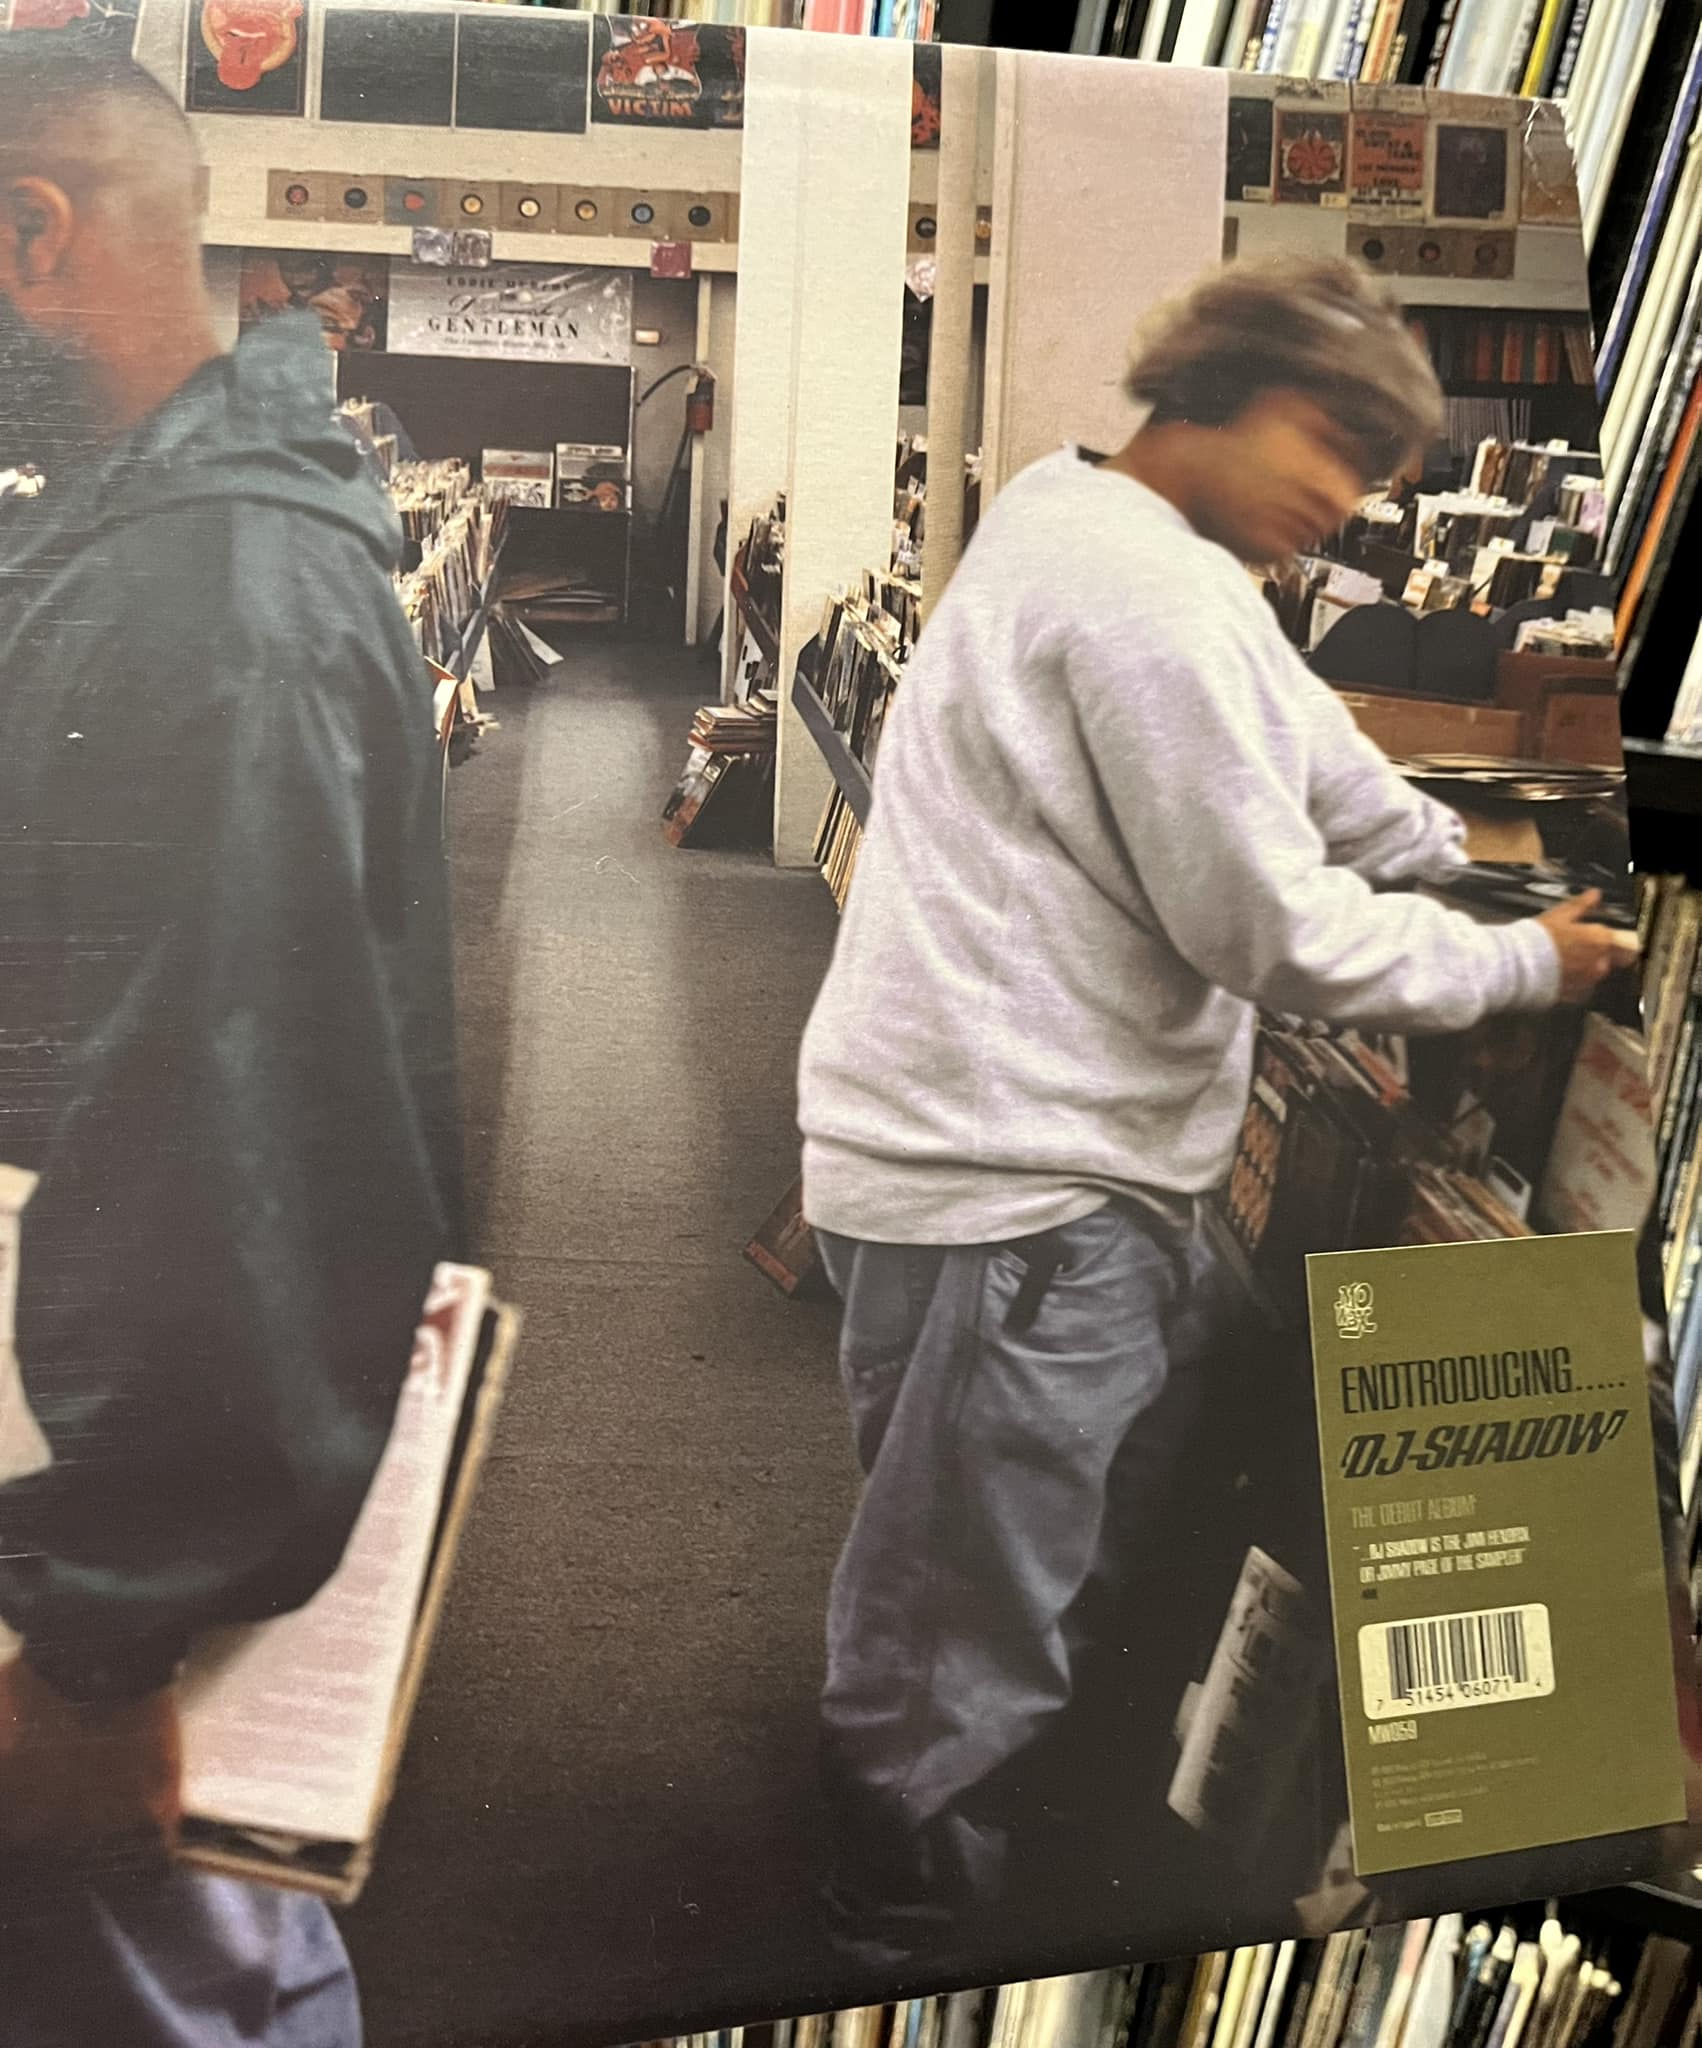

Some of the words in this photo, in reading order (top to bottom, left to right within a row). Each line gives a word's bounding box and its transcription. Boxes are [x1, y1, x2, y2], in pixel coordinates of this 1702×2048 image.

[608, 97, 694, 118] VICTIM
[427, 317, 579, 339] GENTLEMAN
[1461, 1678, 1512, 1699] 06071
